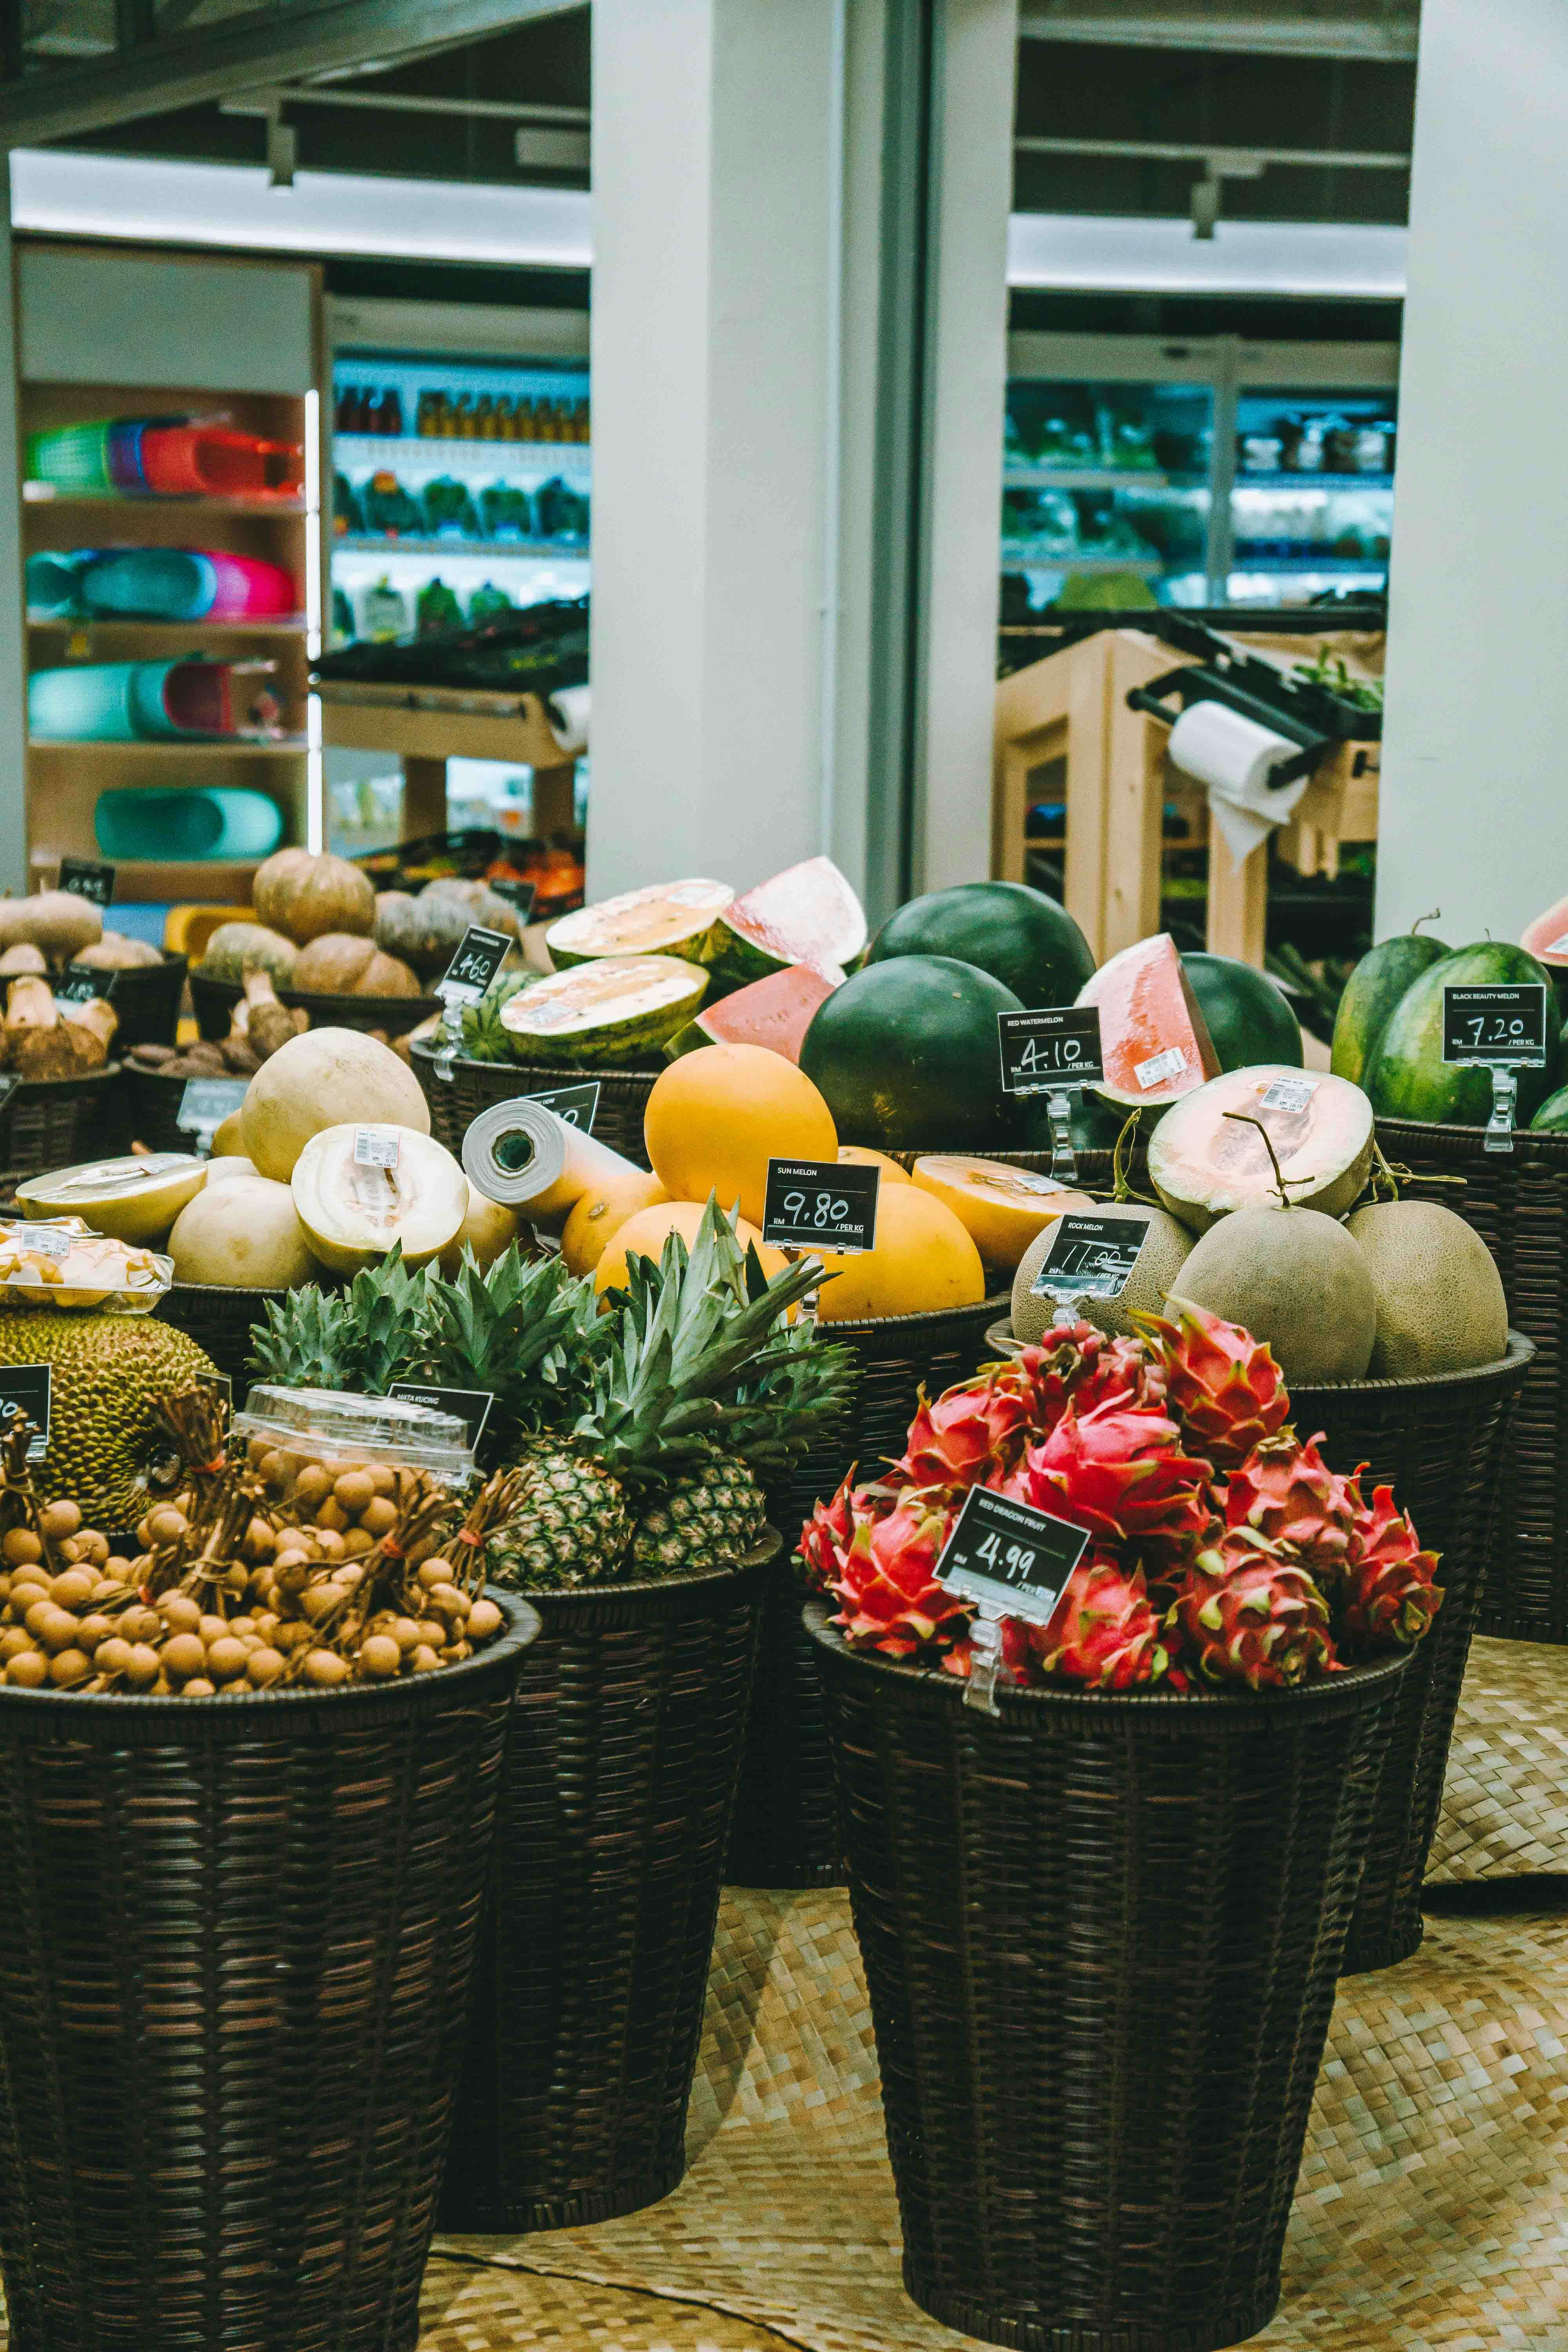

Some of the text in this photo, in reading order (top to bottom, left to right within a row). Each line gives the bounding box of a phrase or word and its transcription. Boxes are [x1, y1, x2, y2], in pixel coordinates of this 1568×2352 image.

[1020, 1017, 1063, 1026] WATERMELON
[1467, 1016, 1524, 1046] 7.20
[1021, 1038, 1080, 1072] 4.10
[784, 1192, 849, 1227] 9.80
[414, 1395, 439, 1405] KUCING
[978, 1498, 1047, 1532] RED DRAGON FRUIT
[975, 1532, 1036, 1579] 4.99
